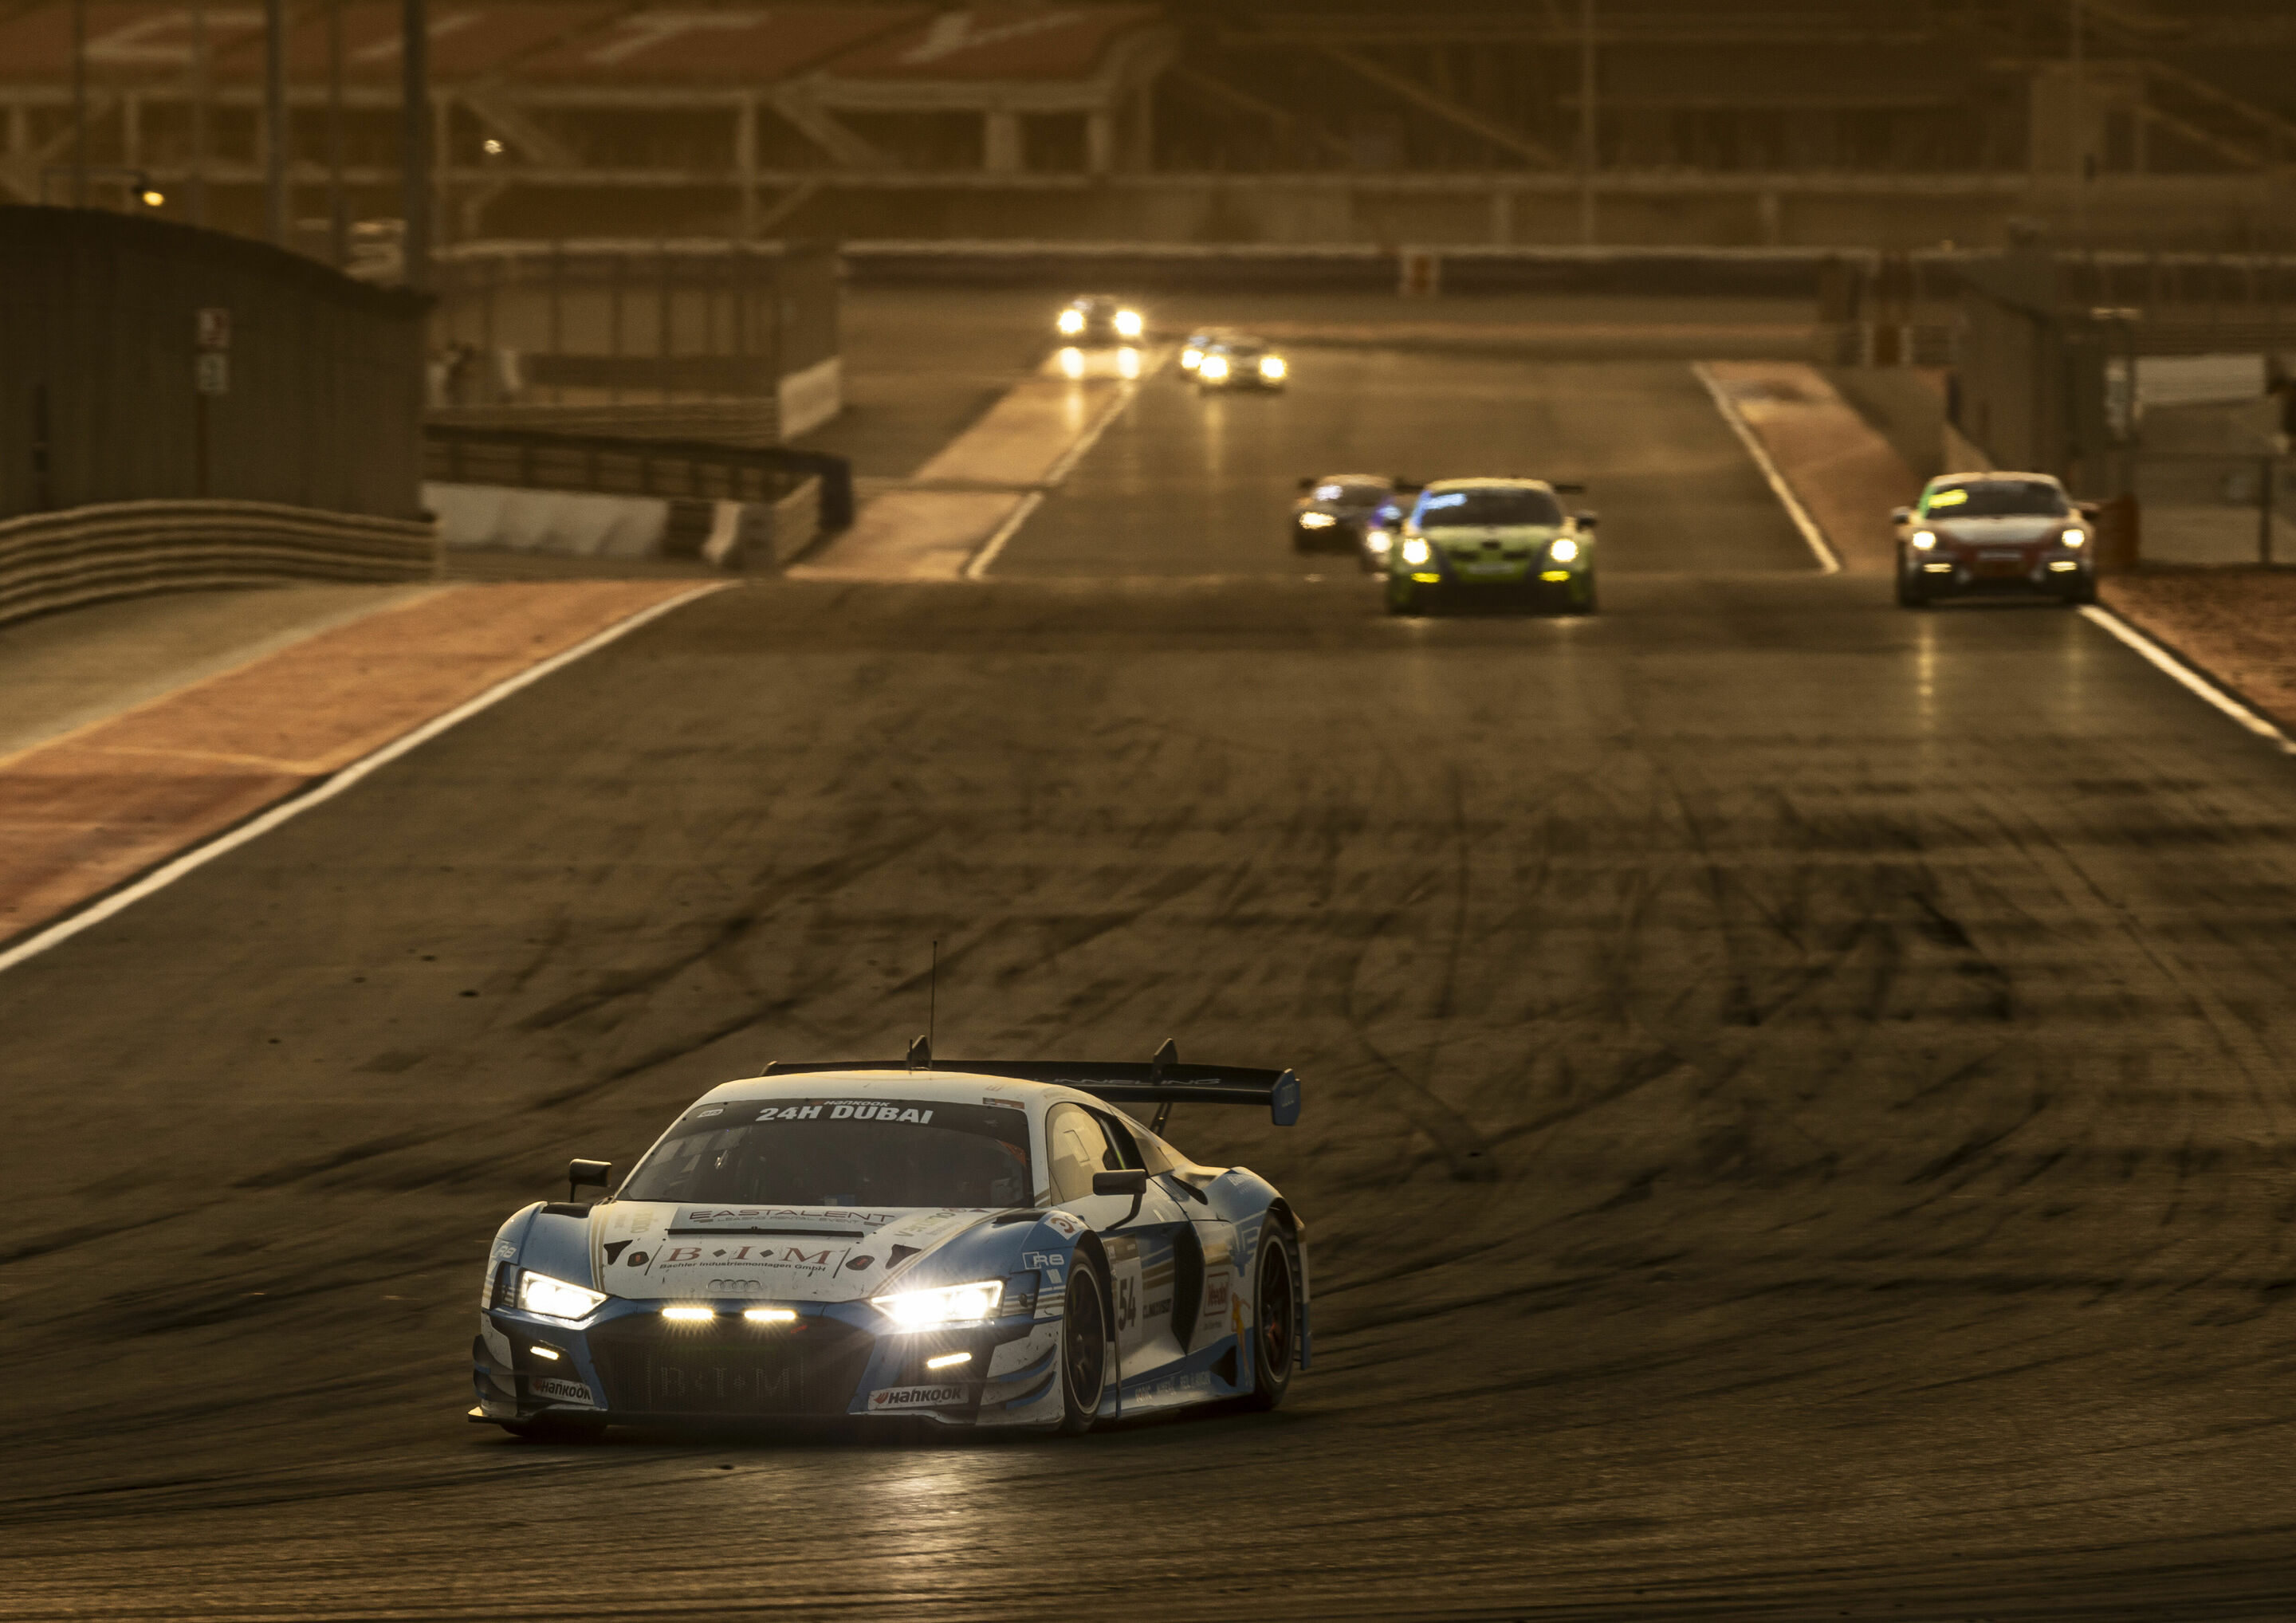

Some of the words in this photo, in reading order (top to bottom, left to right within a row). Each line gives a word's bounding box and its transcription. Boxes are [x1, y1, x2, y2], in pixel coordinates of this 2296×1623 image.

[755, 1106, 822, 1122] 24H
[829, 1105, 934, 1125] DUBAI
[690, 1209, 895, 1222] EASTALENT
[1033, 1253, 1065, 1266] R8
[1119, 1276, 1136, 1331] 54
